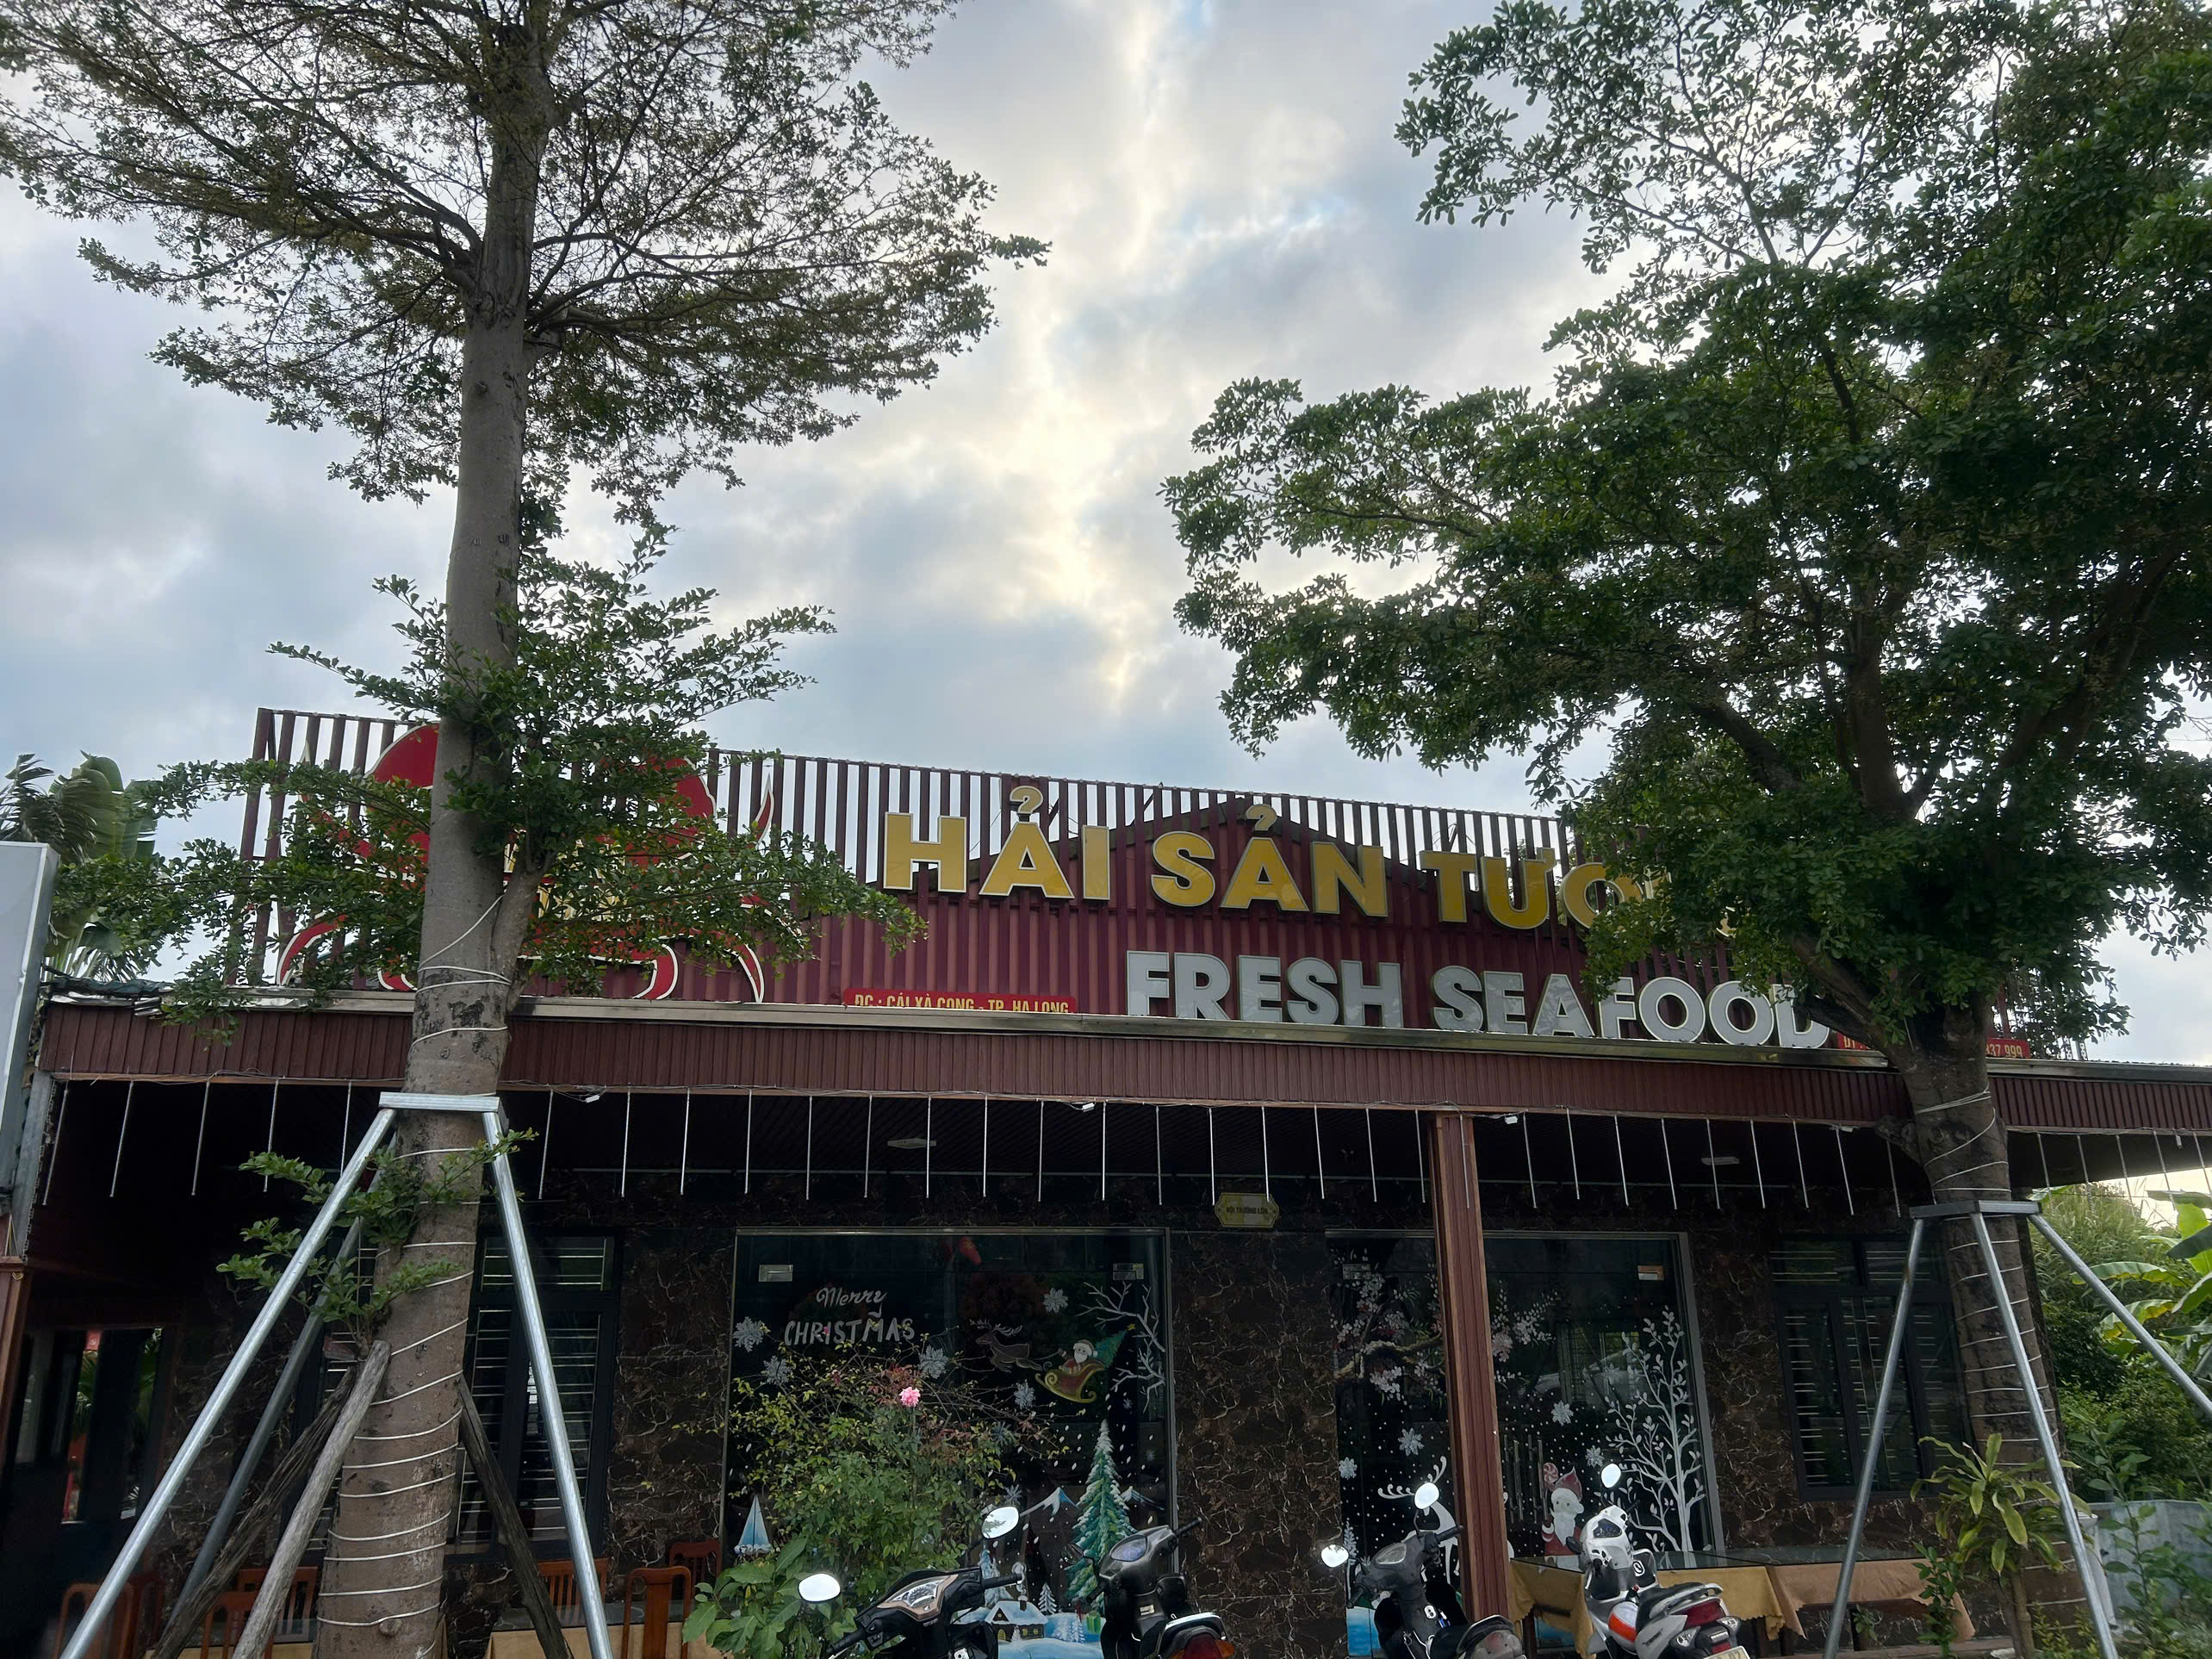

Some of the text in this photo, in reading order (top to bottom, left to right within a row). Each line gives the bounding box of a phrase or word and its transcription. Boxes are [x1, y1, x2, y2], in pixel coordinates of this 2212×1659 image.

[883, 786, 1111, 901] HẢI
[1151, 804, 1388, 917] SẢN
[1127, 950, 1830, 1049] FRESH SEAFOOD
[785, 1318, 916, 1346] CHRISTMAS
[816, 1287, 887, 1318] Merry
